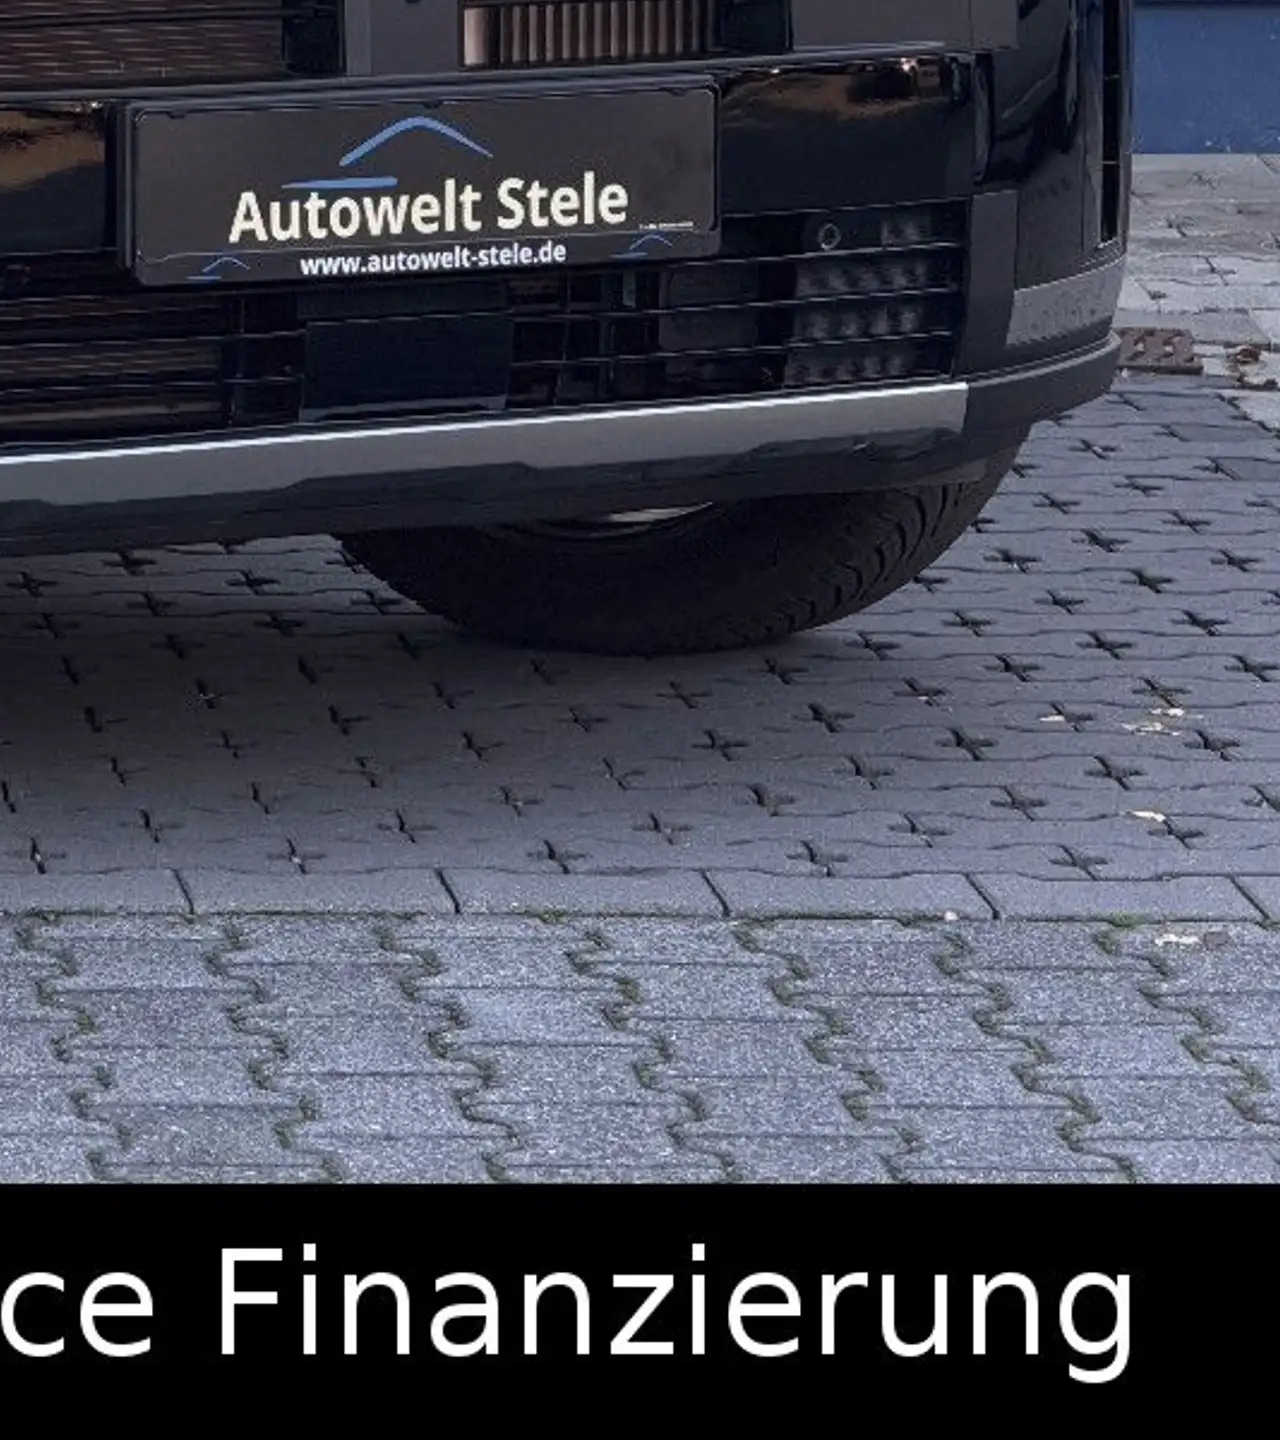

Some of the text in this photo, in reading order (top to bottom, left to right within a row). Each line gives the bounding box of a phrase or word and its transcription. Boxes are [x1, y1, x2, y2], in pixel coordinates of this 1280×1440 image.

[228, 170, 630, 244] Autowelt Stele
[300, 240, 568, 277] www.autowelt-stele.de
